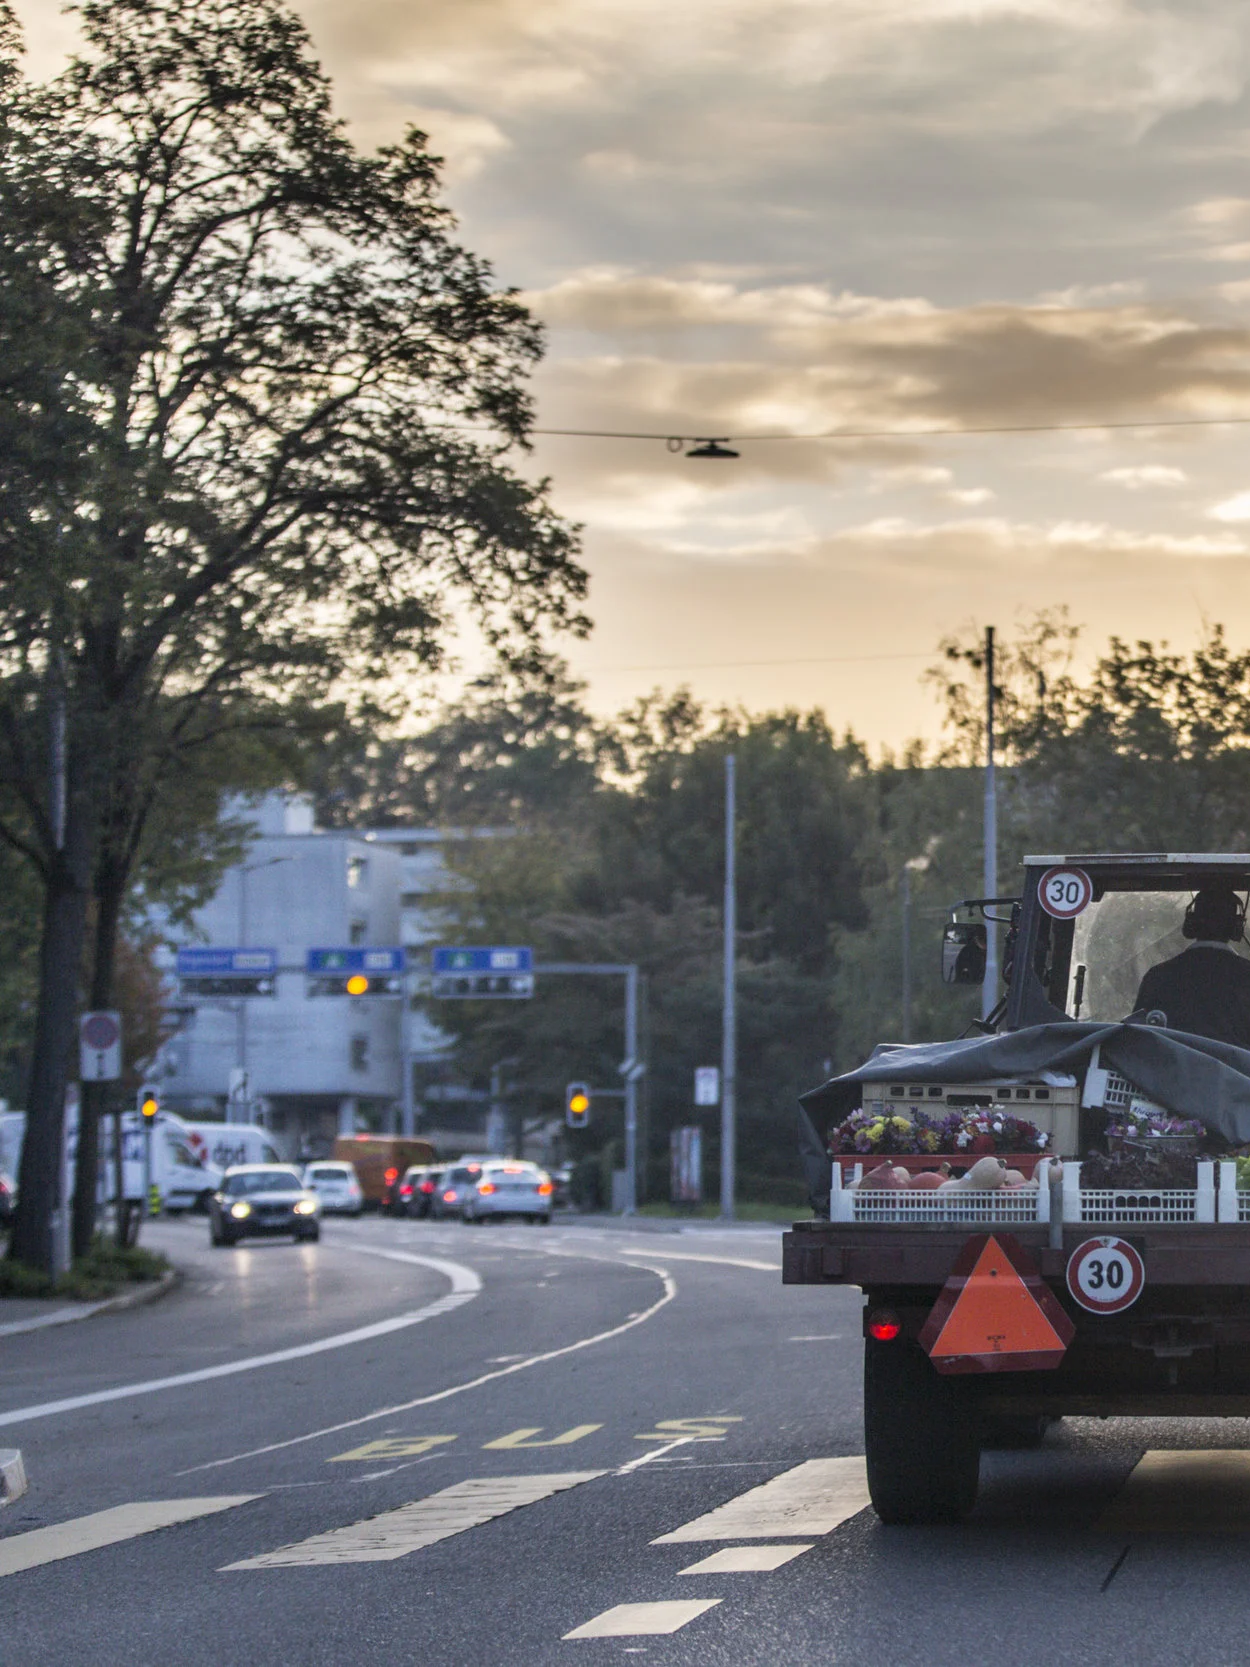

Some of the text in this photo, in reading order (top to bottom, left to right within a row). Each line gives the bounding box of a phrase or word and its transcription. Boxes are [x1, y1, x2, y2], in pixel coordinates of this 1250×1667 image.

[1050, 880, 1079, 904] 30
[1088, 1260, 1124, 1290] 30
[324, 1416, 744, 1463] BUS
